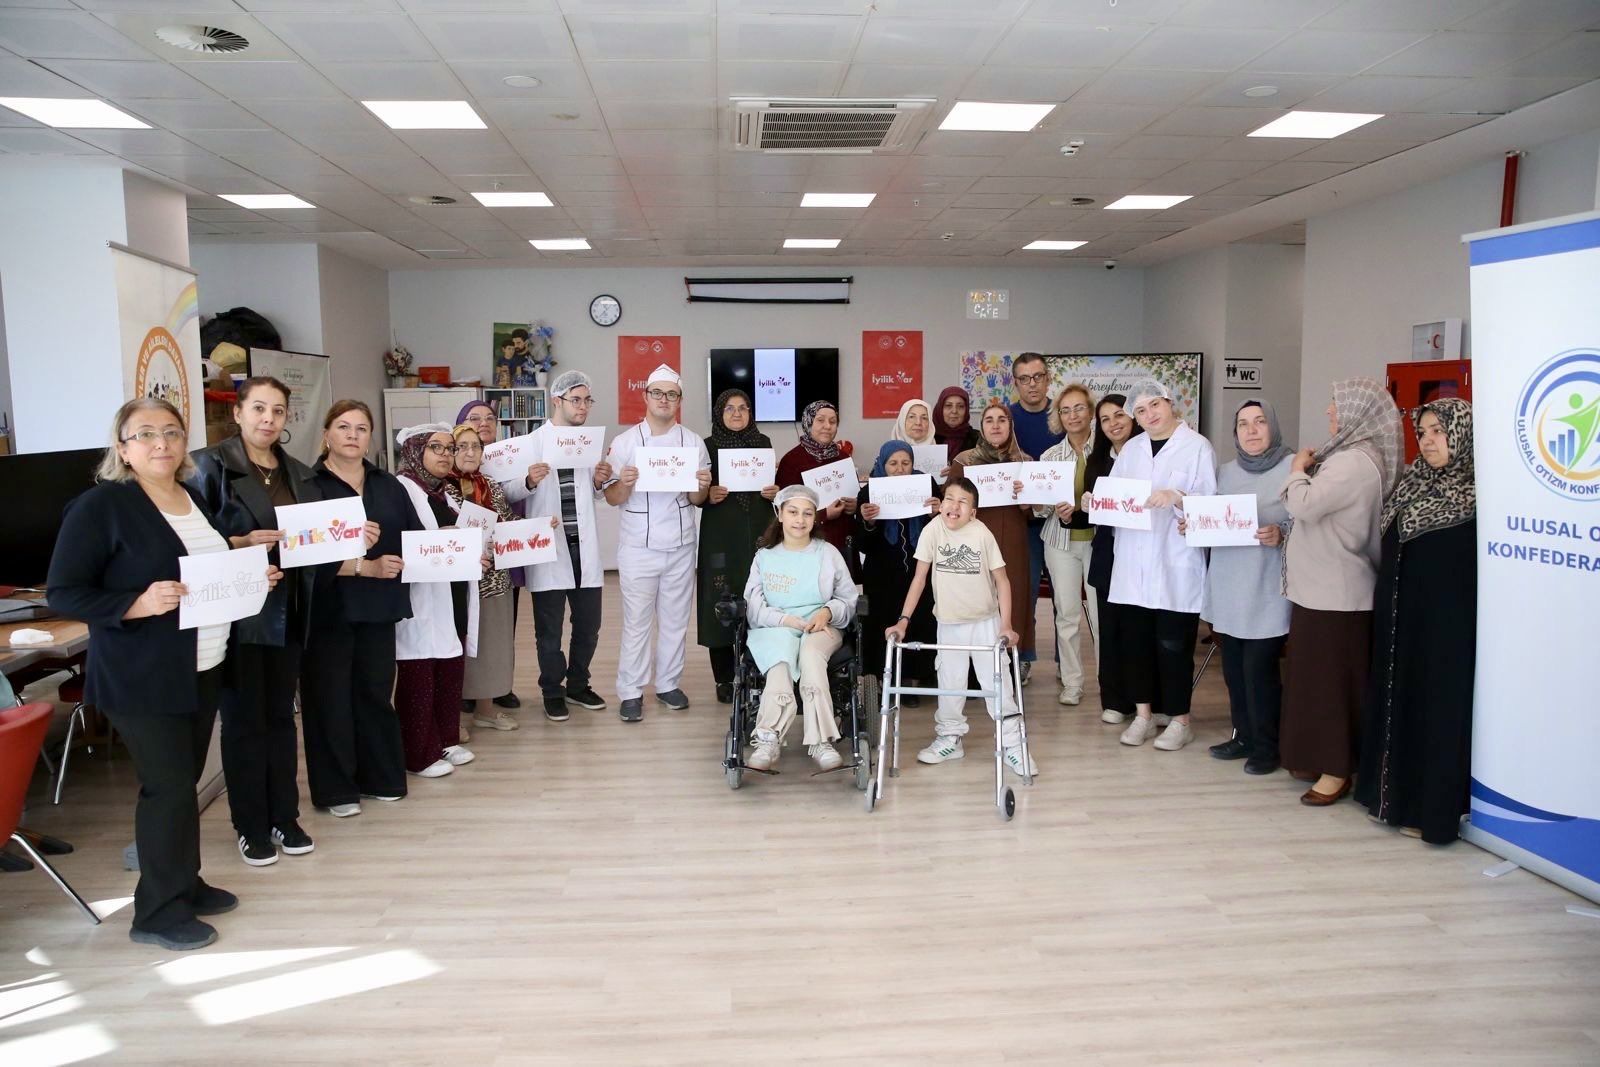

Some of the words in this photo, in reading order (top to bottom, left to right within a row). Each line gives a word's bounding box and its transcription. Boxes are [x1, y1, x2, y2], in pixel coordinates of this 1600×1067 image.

[872, 374, 894, 385] İyilik
[1240, 370, 1255, 381] WC
[628, 379, 647, 391] İyili
[759, 379, 776, 388] İyilik
[557, 437, 576, 446] İyilik
[484, 451, 504, 460] İyilik
[1517, 419, 1537, 466] ULUSAL
[1535, 464, 1567, 491] OTİZM
[649, 458, 668, 467] İyilik
[731, 459, 749, 469] İyilik
[815, 476, 832, 486] İyilik
[977, 476, 996, 485] İyilik
[1030, 472, 1047, 480] İyilik
[1507, 516, 1582, 540] ULUSAL
[420, 544, 445, 556] İyilik
[1487, 541, 1600, 572] KONFEDERA
